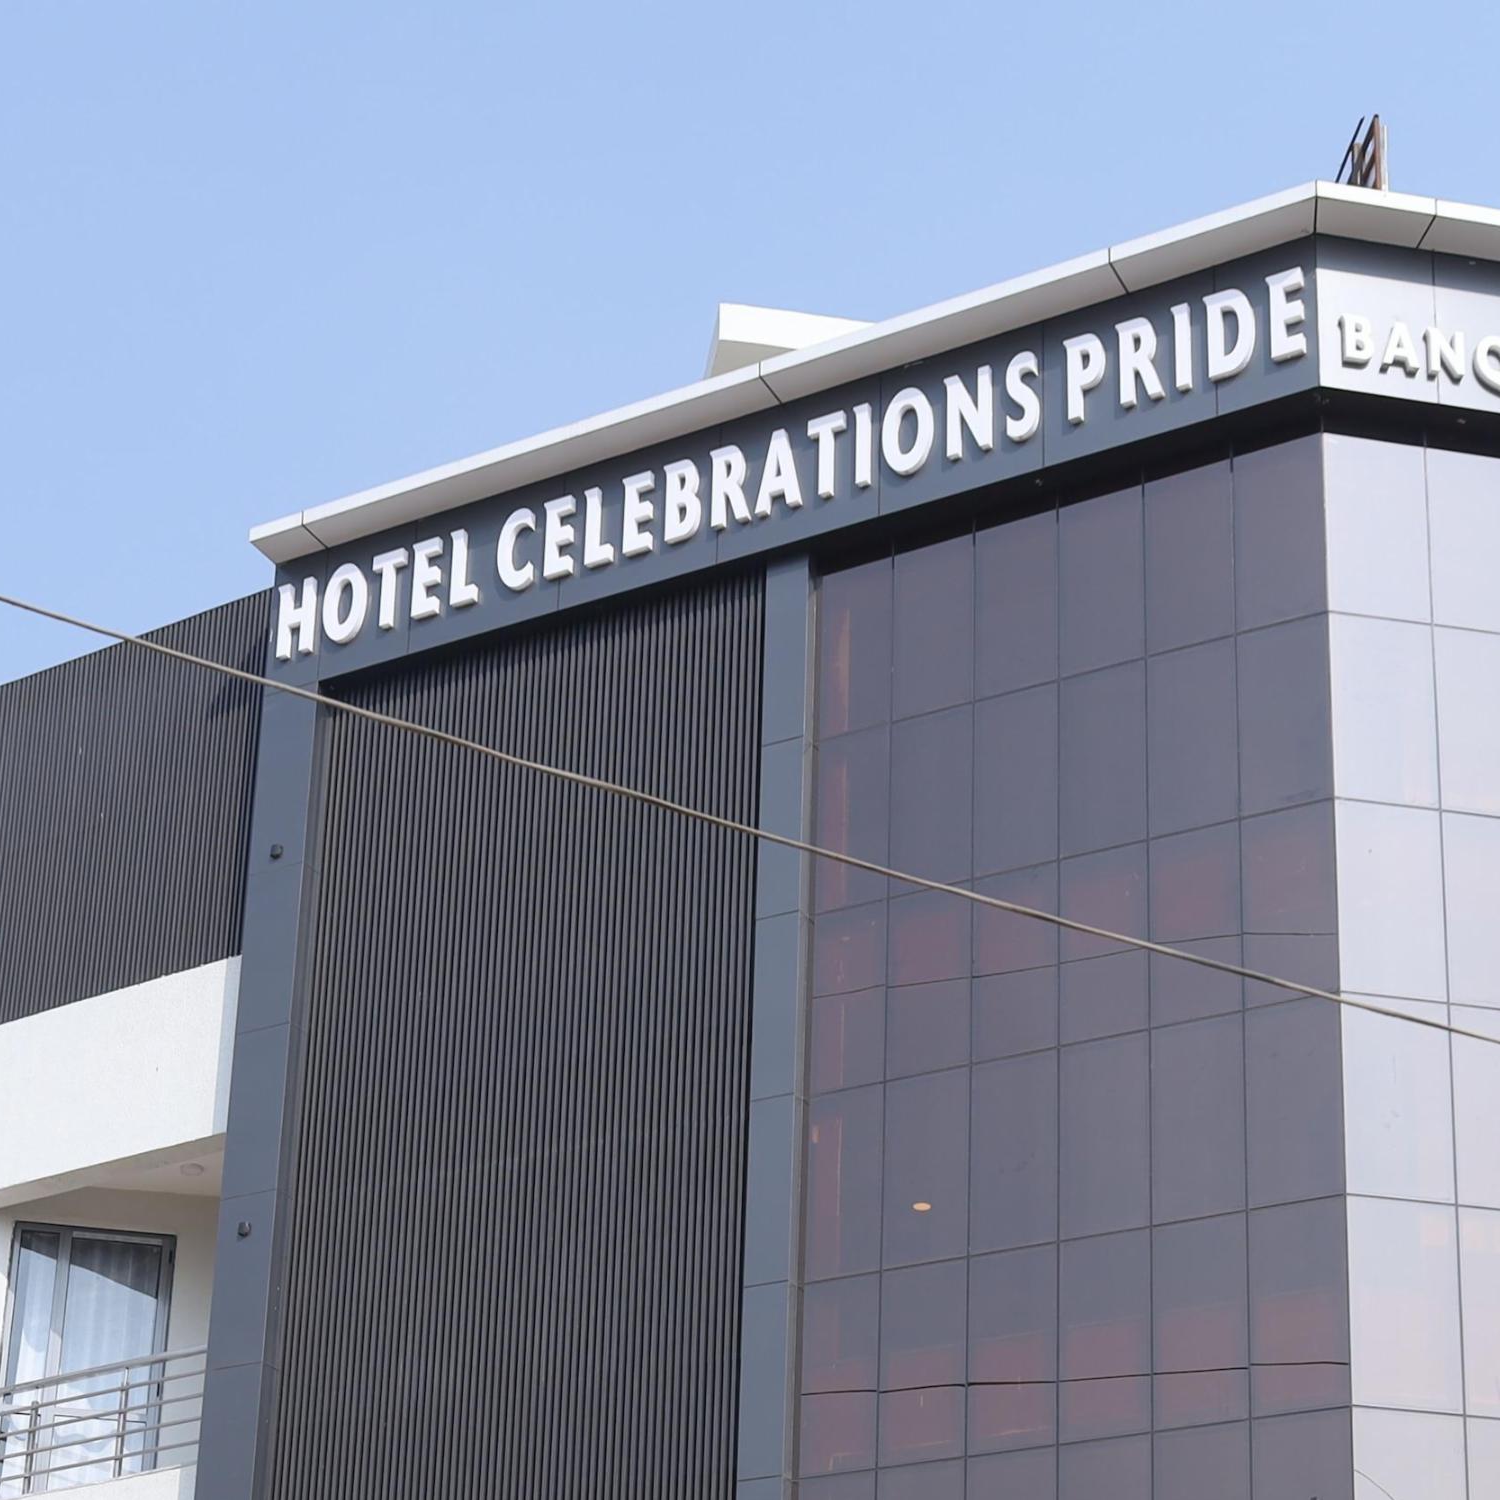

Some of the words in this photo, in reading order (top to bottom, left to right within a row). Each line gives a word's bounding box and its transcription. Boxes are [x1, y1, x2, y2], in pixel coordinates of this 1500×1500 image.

[275, 528, 479, 660] HOTEL
[496, 349, 1041, 592] CELEBRATIONS
[1062, 266, 1307, 425] PRIDE
